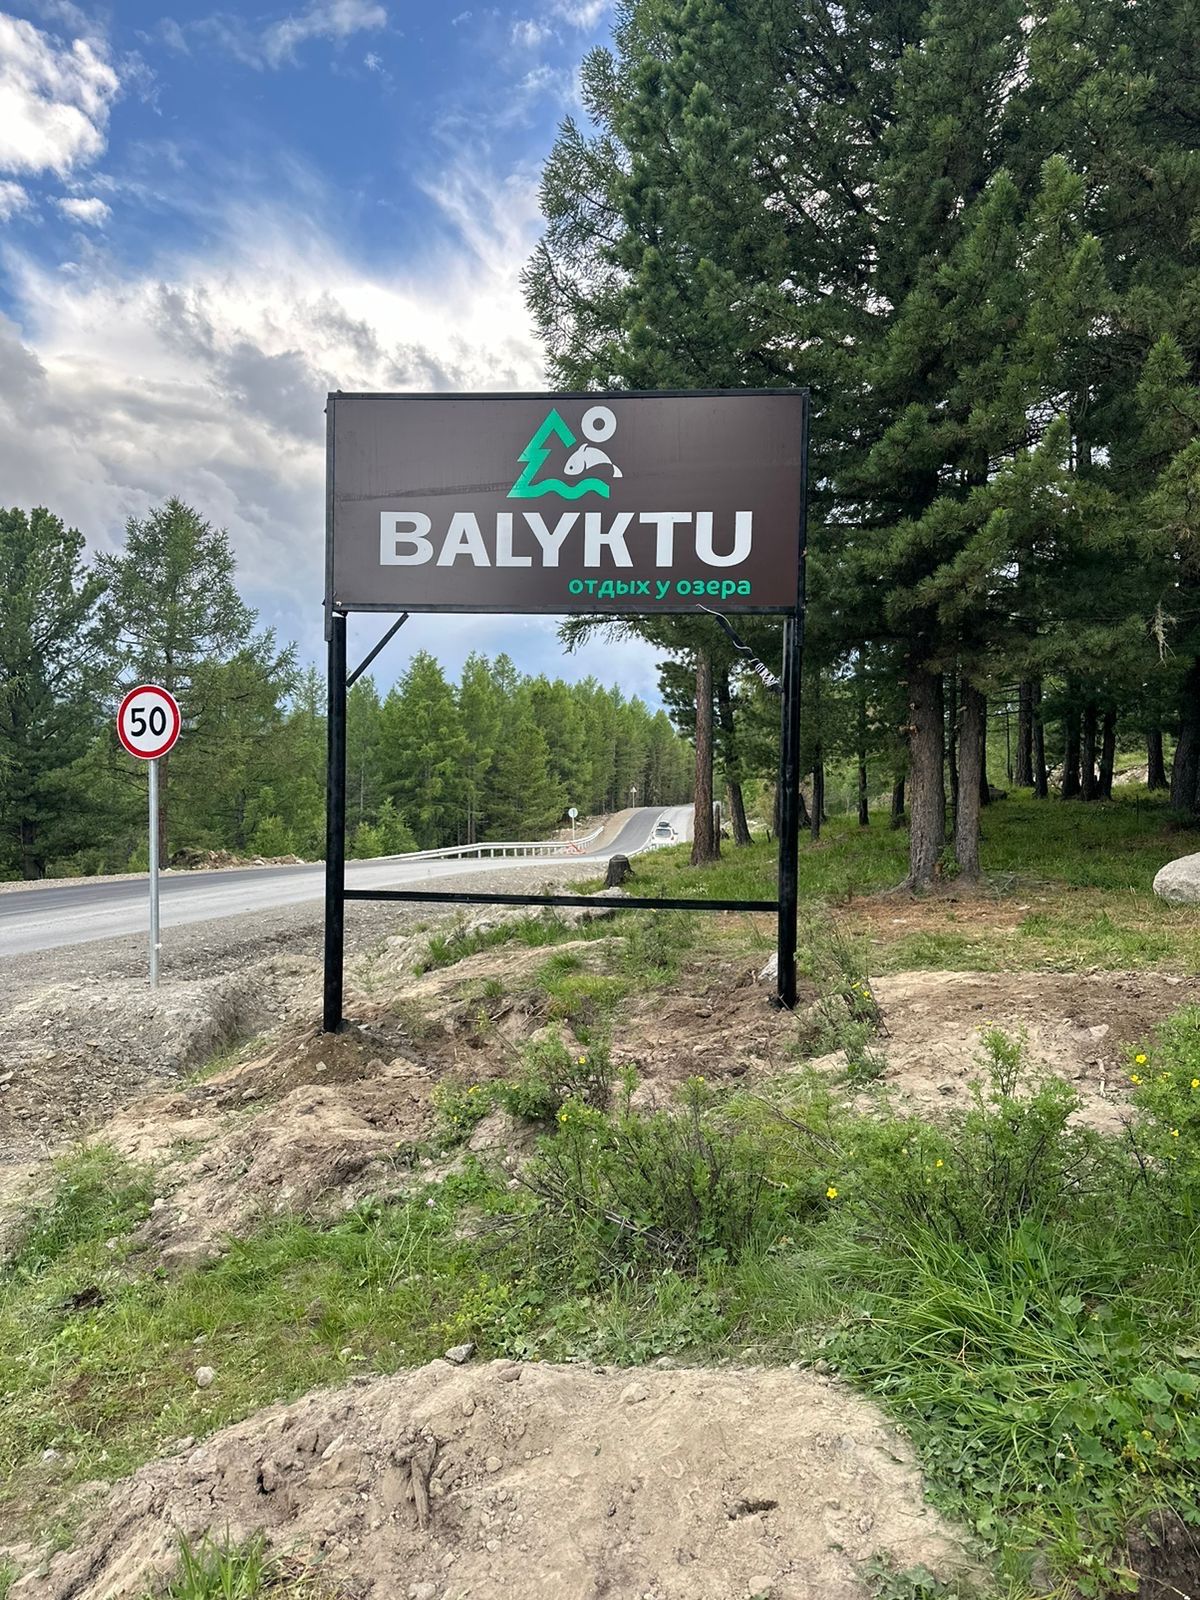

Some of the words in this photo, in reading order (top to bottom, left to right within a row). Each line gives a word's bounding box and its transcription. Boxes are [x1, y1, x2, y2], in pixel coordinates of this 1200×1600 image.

[379, 510, 753, 568] BALYKTU
[568, 579, 650, 599] отдых
[655, 580, 671, 600] у
[676, 580, 751, 600] озера
[131, 706, 167, 737] 50
